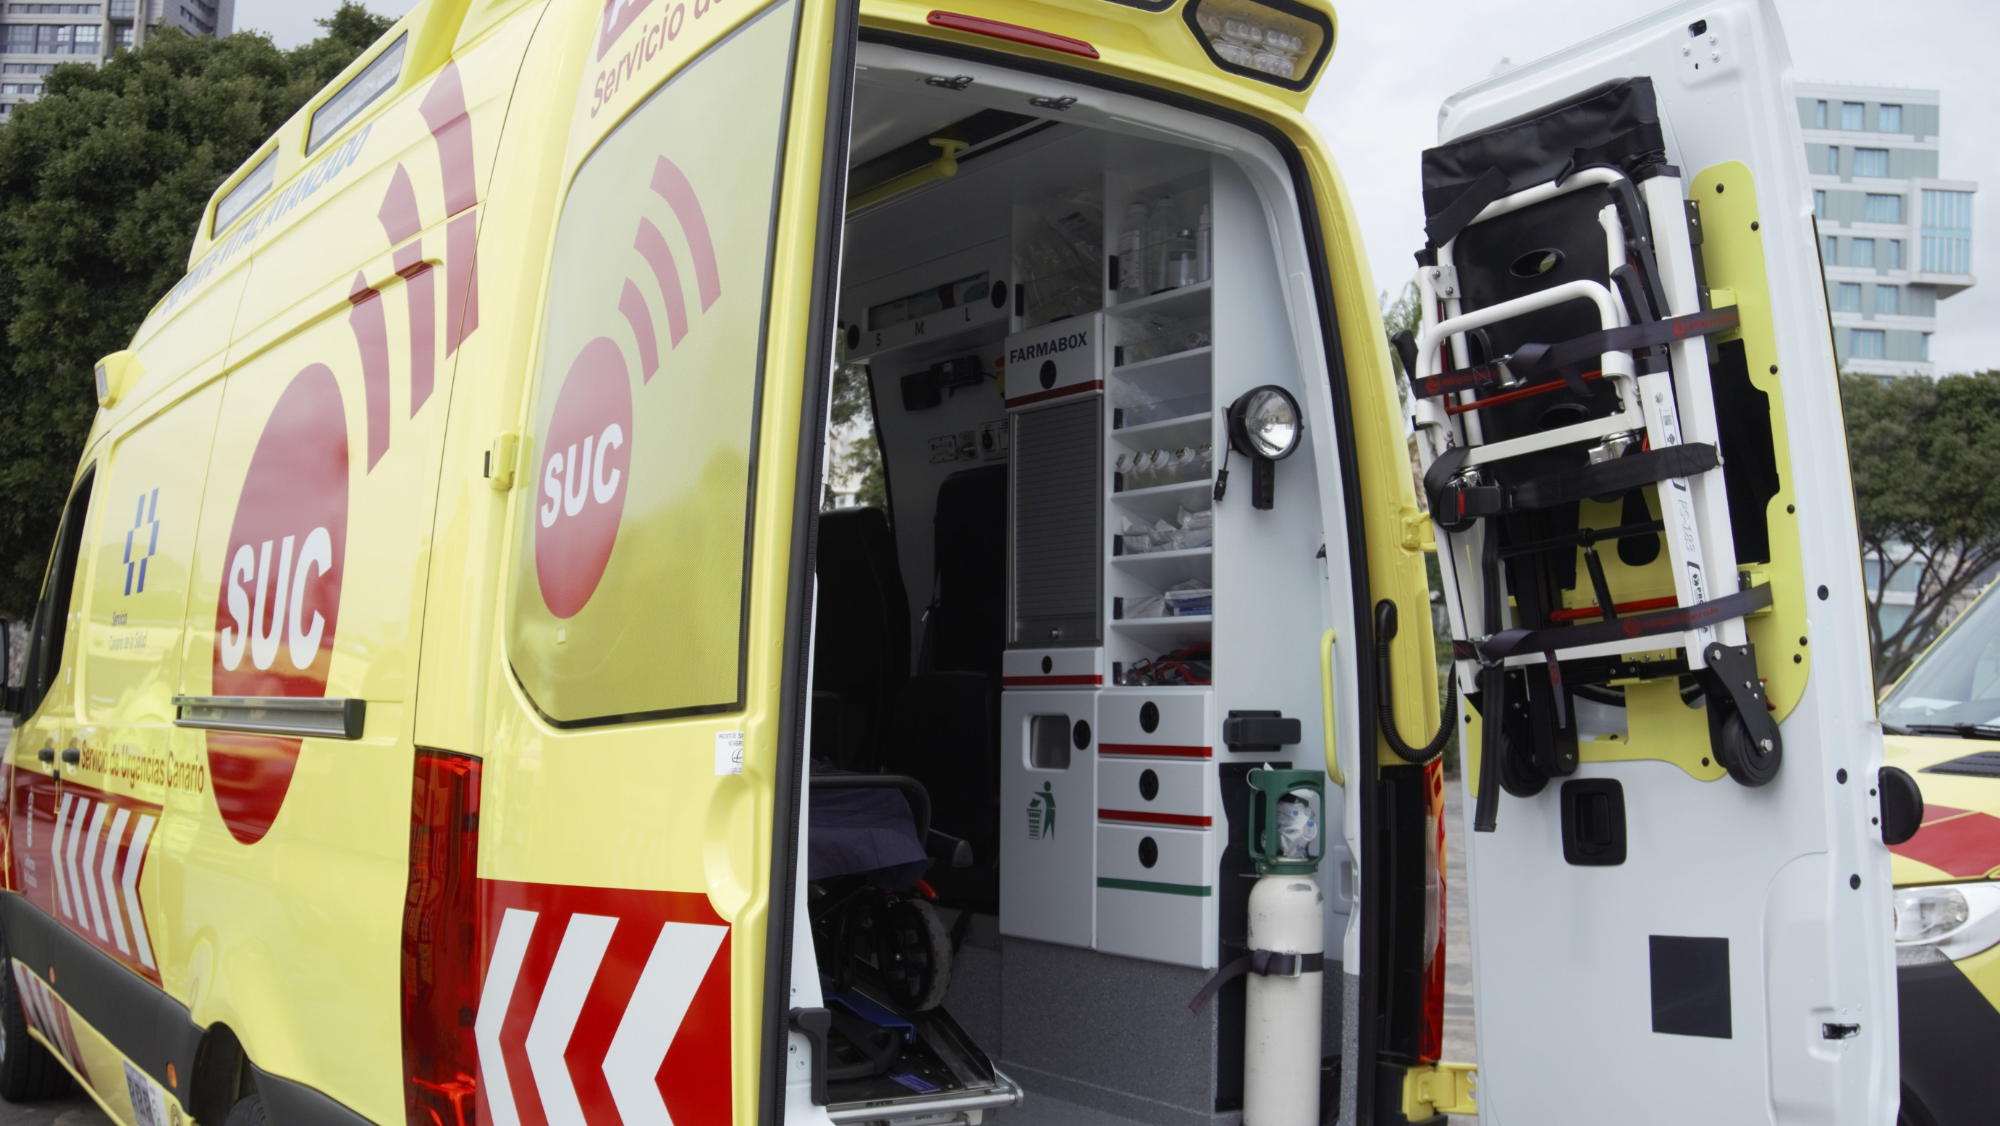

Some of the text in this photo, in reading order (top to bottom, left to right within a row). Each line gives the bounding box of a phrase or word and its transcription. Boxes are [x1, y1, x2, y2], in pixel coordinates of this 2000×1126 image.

[590, 2, 685, 119] Servicio
[260, 122, 373, 232] AVANZADO
[875, 307, 971, 347] S M L
[1009, 331, 1088, 364] FARMABOX
[541, 423, 623, 529] SUC
[221, 526, 332, 672] SUC
[81, 739, 205, 794] Servicio de Urgencias Canario
